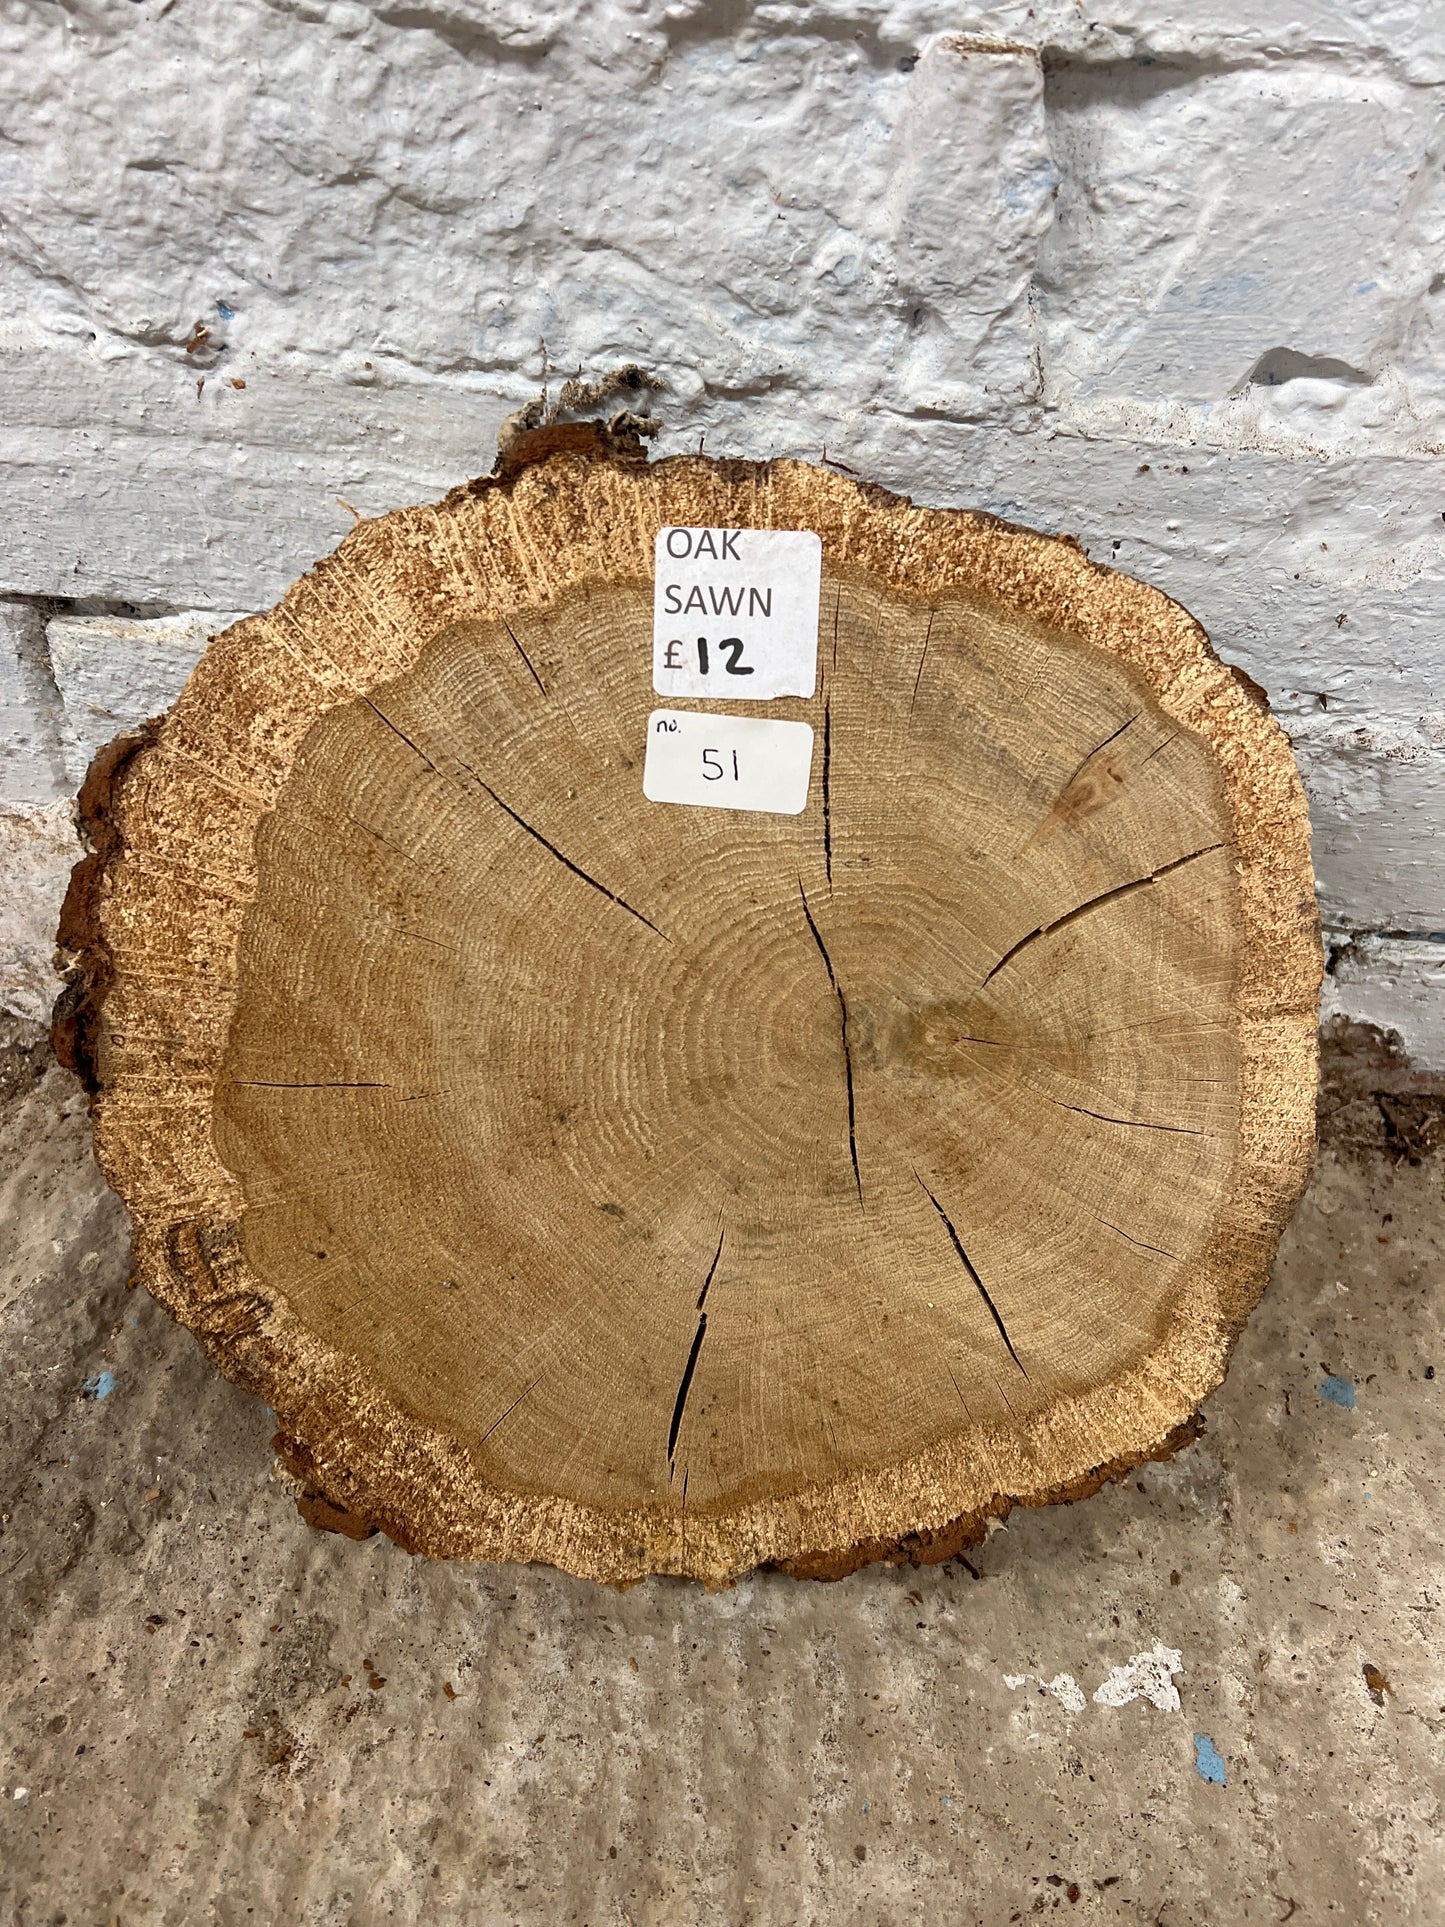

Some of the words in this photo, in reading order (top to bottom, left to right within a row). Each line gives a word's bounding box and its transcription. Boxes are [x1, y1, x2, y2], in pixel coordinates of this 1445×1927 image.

[666, 528, 741, 561] OAK
[664, 584, 772, 617] SAWN
[663, 636, 755, 676] £12
[656, 720, 682, 734] no.
[702, 748, 739, 781] 51
